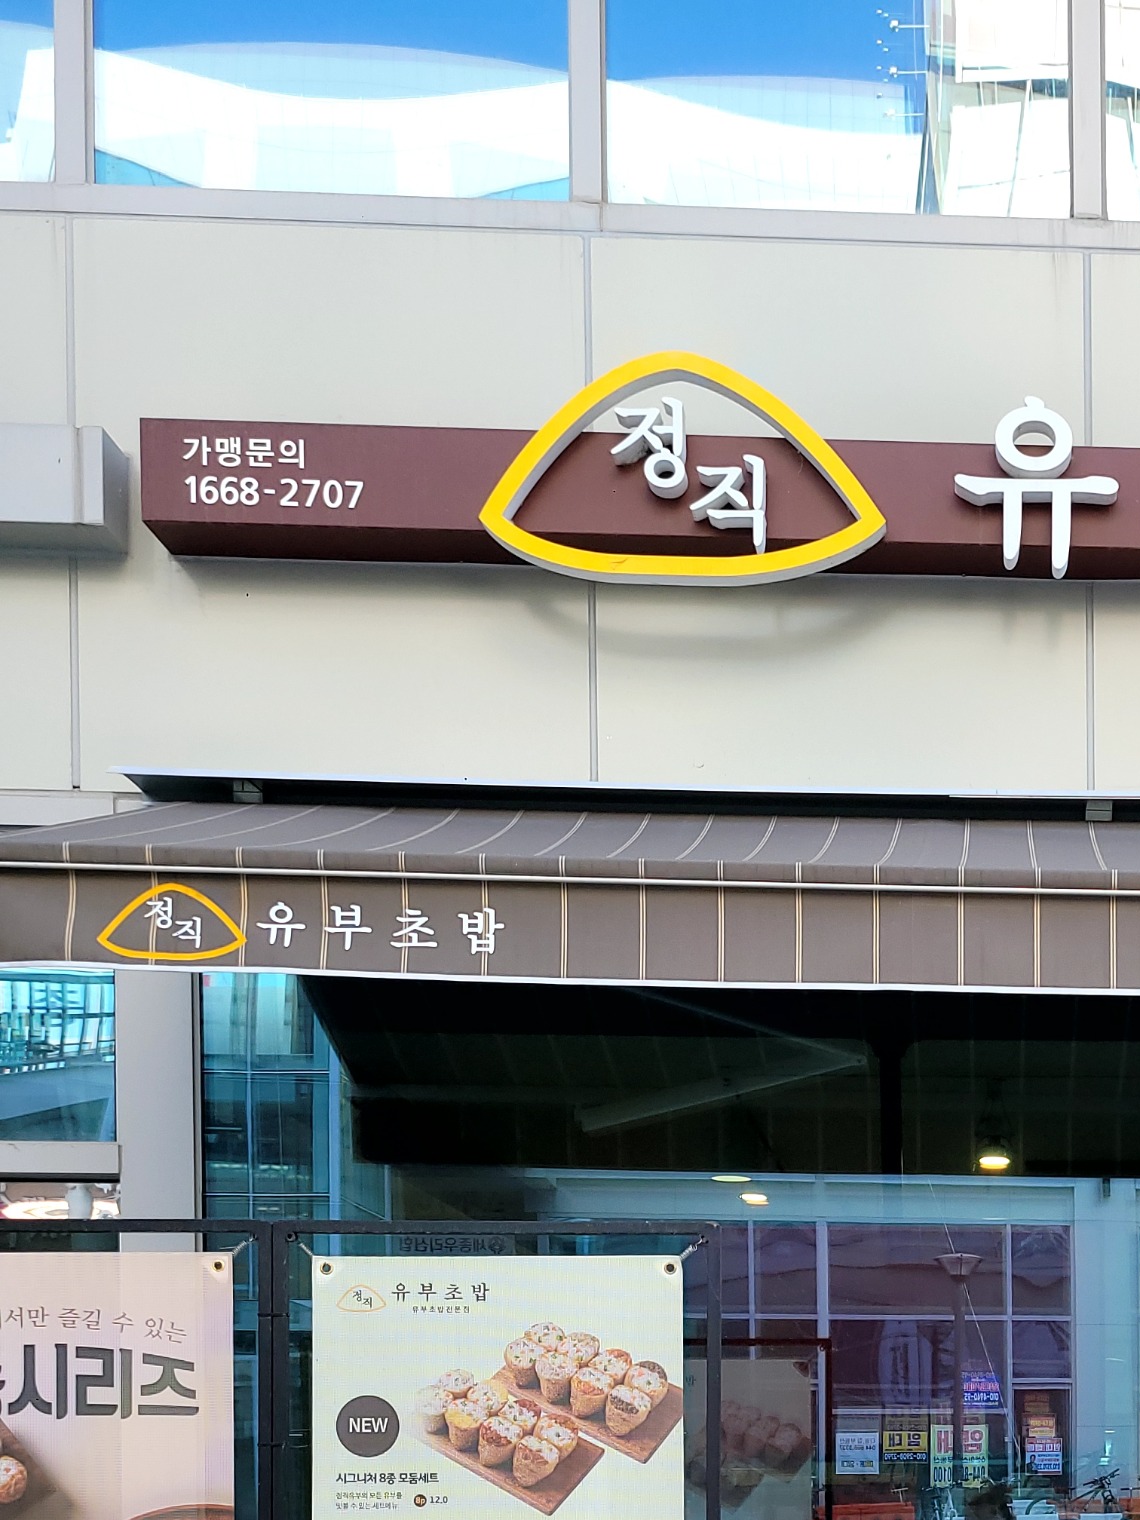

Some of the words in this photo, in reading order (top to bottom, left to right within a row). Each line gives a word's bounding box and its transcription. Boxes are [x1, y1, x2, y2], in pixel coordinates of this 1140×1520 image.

[181, 436, 306, 470] 가맹문의
[609, 396, 767, 554] 정직
[183, 475, 364, 510] 1668-2707
[144, 897, 203, 948] 정직
[256, 902, 505, 955] 유부초밥
[353, 1290, 373, 1309] 정직
[391, 1282, 490, 1303] 유부초밥
[0, 1306, 50, 1329] 서만
[58, 1307, 101, 1330] 즐길
[112, 1311, 134, 1333] 수
[144, 1317, 187, 1344] 있는
[0, 1343, 199, 1420] 시리즈
[348, 1417, 389, 1434] NEW
[336, 1472, 377, 1484] 시그니처
[379, 1472, 397, 1485] 8종
[398, 1472, 439, 1484] 모둠세트
[429, 1495, 448, 1504] 12.0
